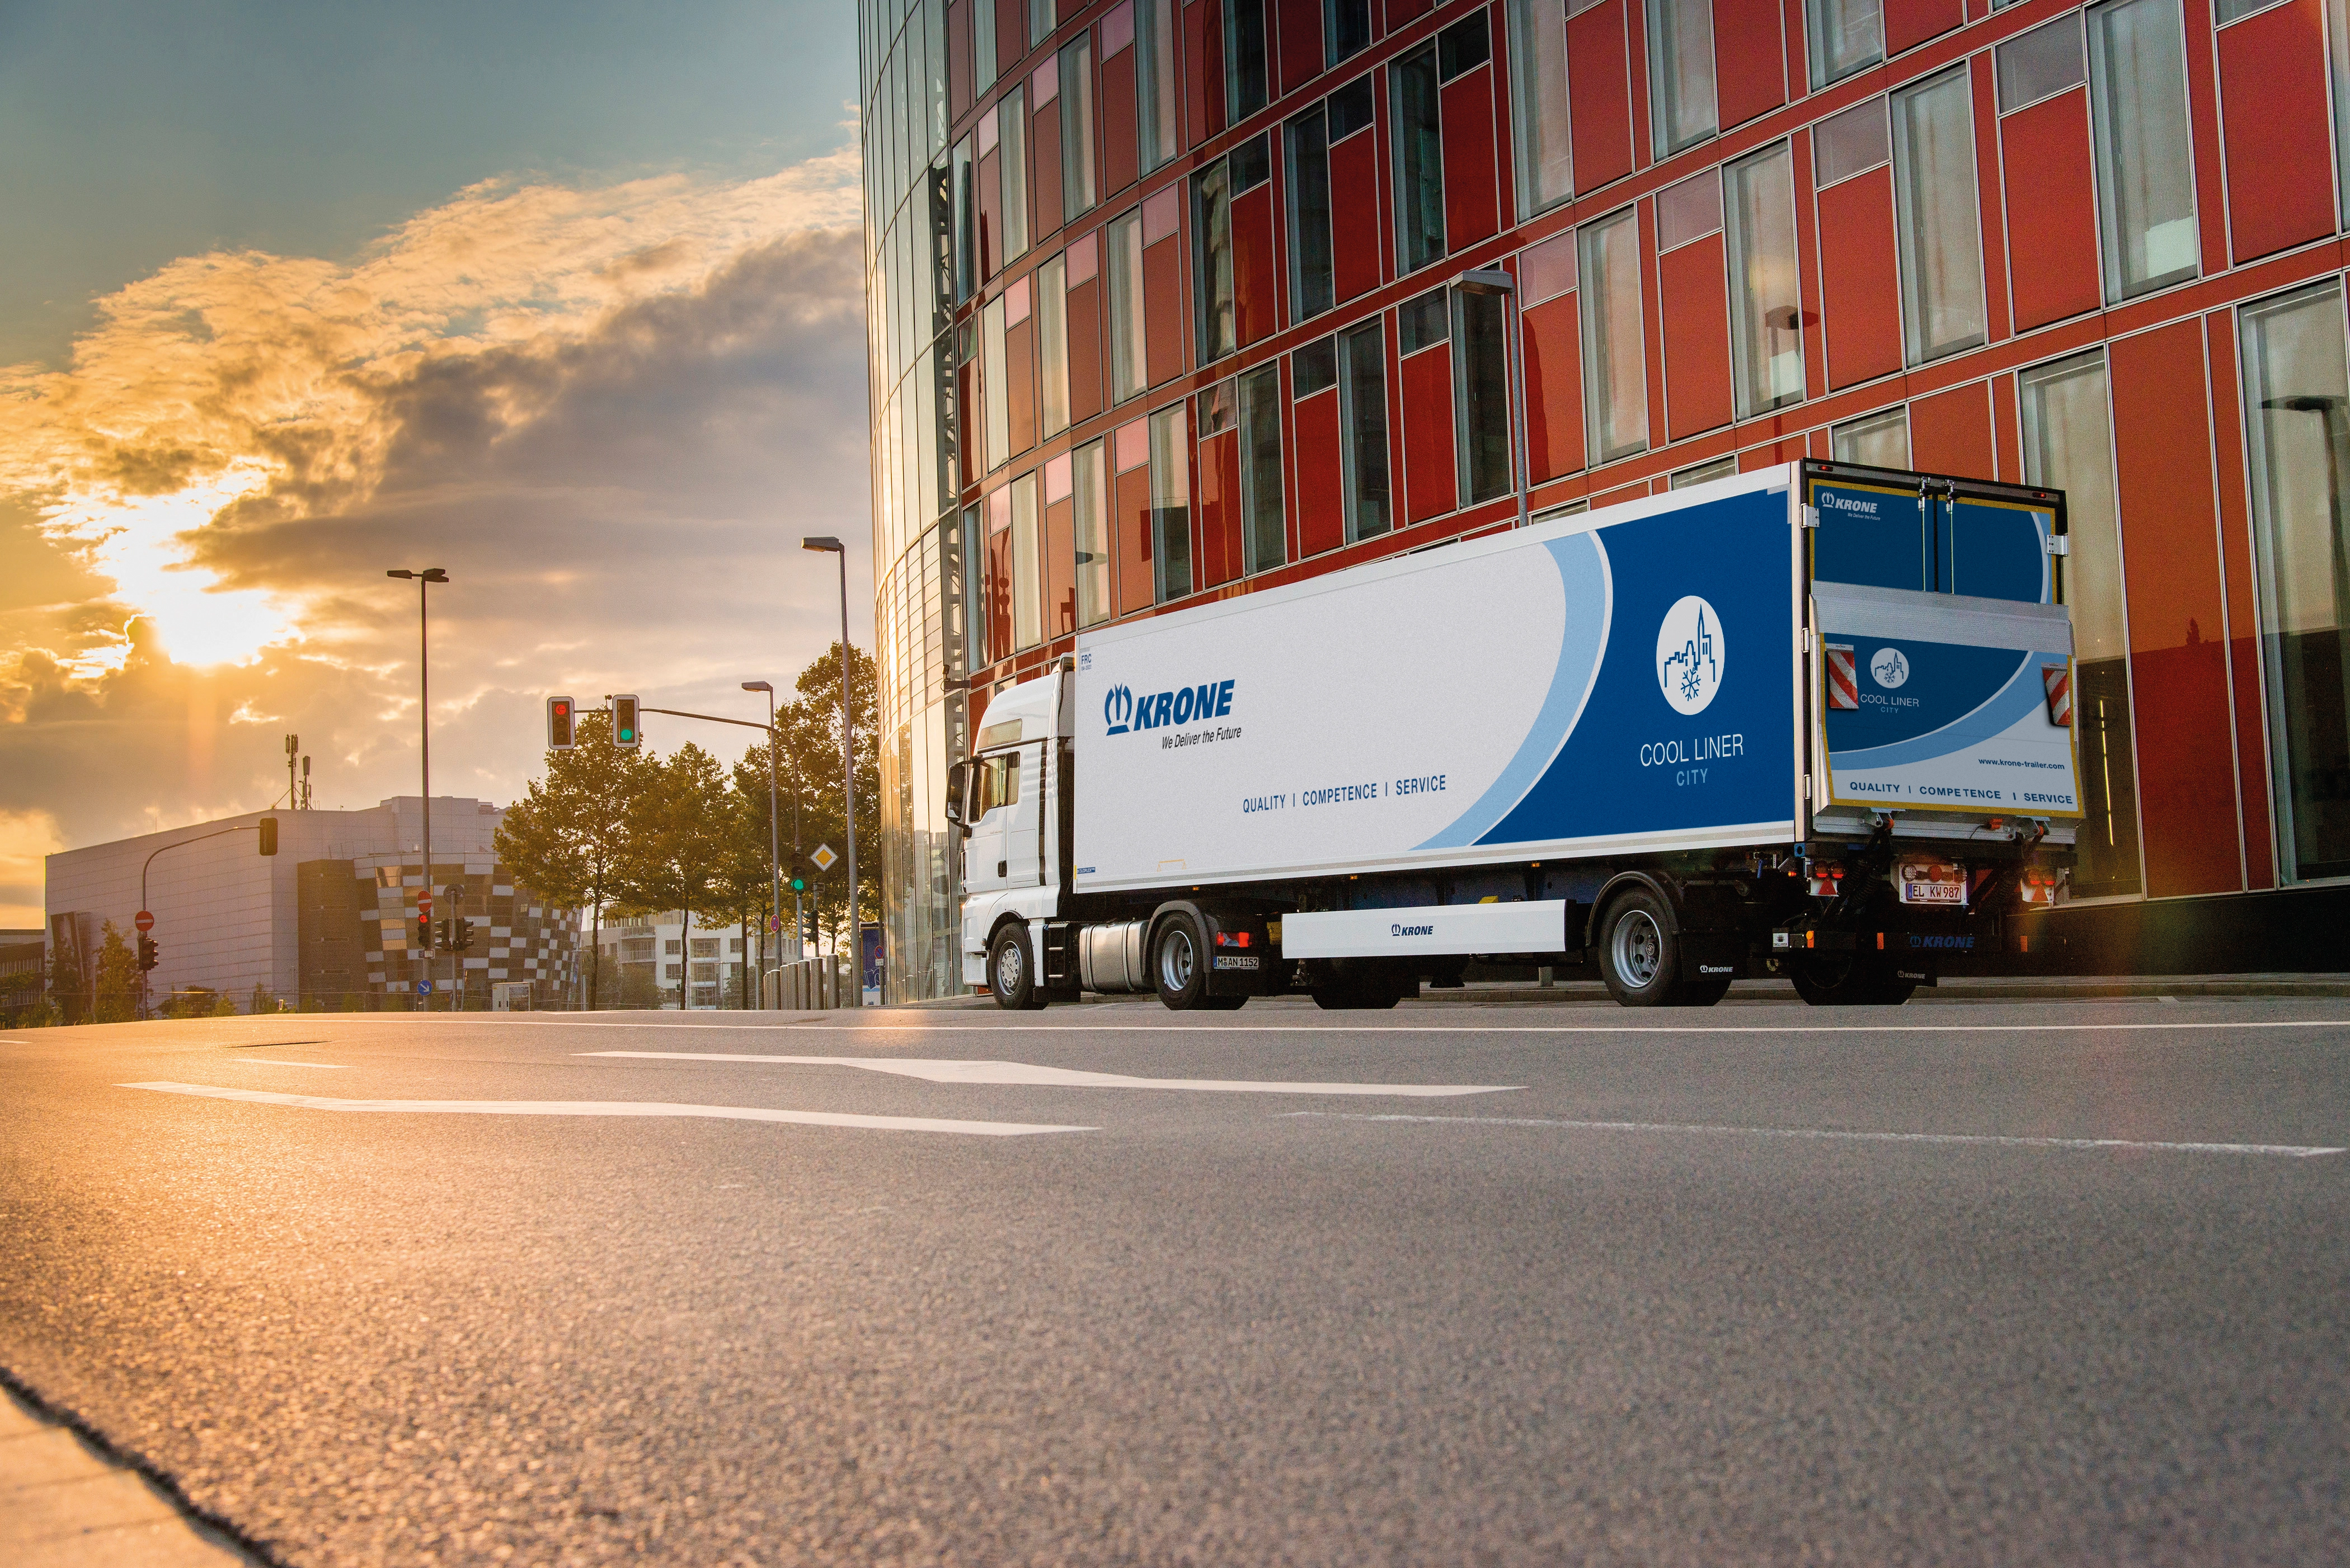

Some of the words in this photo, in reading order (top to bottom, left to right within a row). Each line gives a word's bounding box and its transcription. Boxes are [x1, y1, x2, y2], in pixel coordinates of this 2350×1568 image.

[1835, 498, 1877, 514] KRONE
[1081, 653, 1092, 665] FRC
[1134, 679, 1235, 732] KRONE
[1860, 694, 1888, 705] COOL
[1891, 696, 1919, 707] LINER
[1162, 736, 1173, 750] We
[1174, 732, 1201, 748] Deliver
[1202, 729, 1215, 743] the
[1216, 727, 1242, 741] Future
[1640, 740, 1689, 767] COOL
[1695, 733, 1743, 761] LINER
[1978, 759, 2065, 770] www.krone-trailer.com
[1676, 768, 1708, 787] CITY
[1243, 794, 1286, 813] QUALITY
[1303, 782, 1378, 807] COMPETENCE
[1395, 774, 1446, 796] SERVICE
[1850, 781, 1900, 793] QUALITY
[2023, 793, 2073, 804] SERVICE
[1913, 886, 1924, 897] EL
[1930, 886, 1942, 897] KW
[1943, 887, 1959, 898] 987
[1401, 925, 1434, 936] KRONE
[1923, 936, 1976, 948] KRONE
[1218, 957, 1223, 967] M
[1228, 957, 1238, 967] AN
[1239, 958, 1258, 967] 1152
